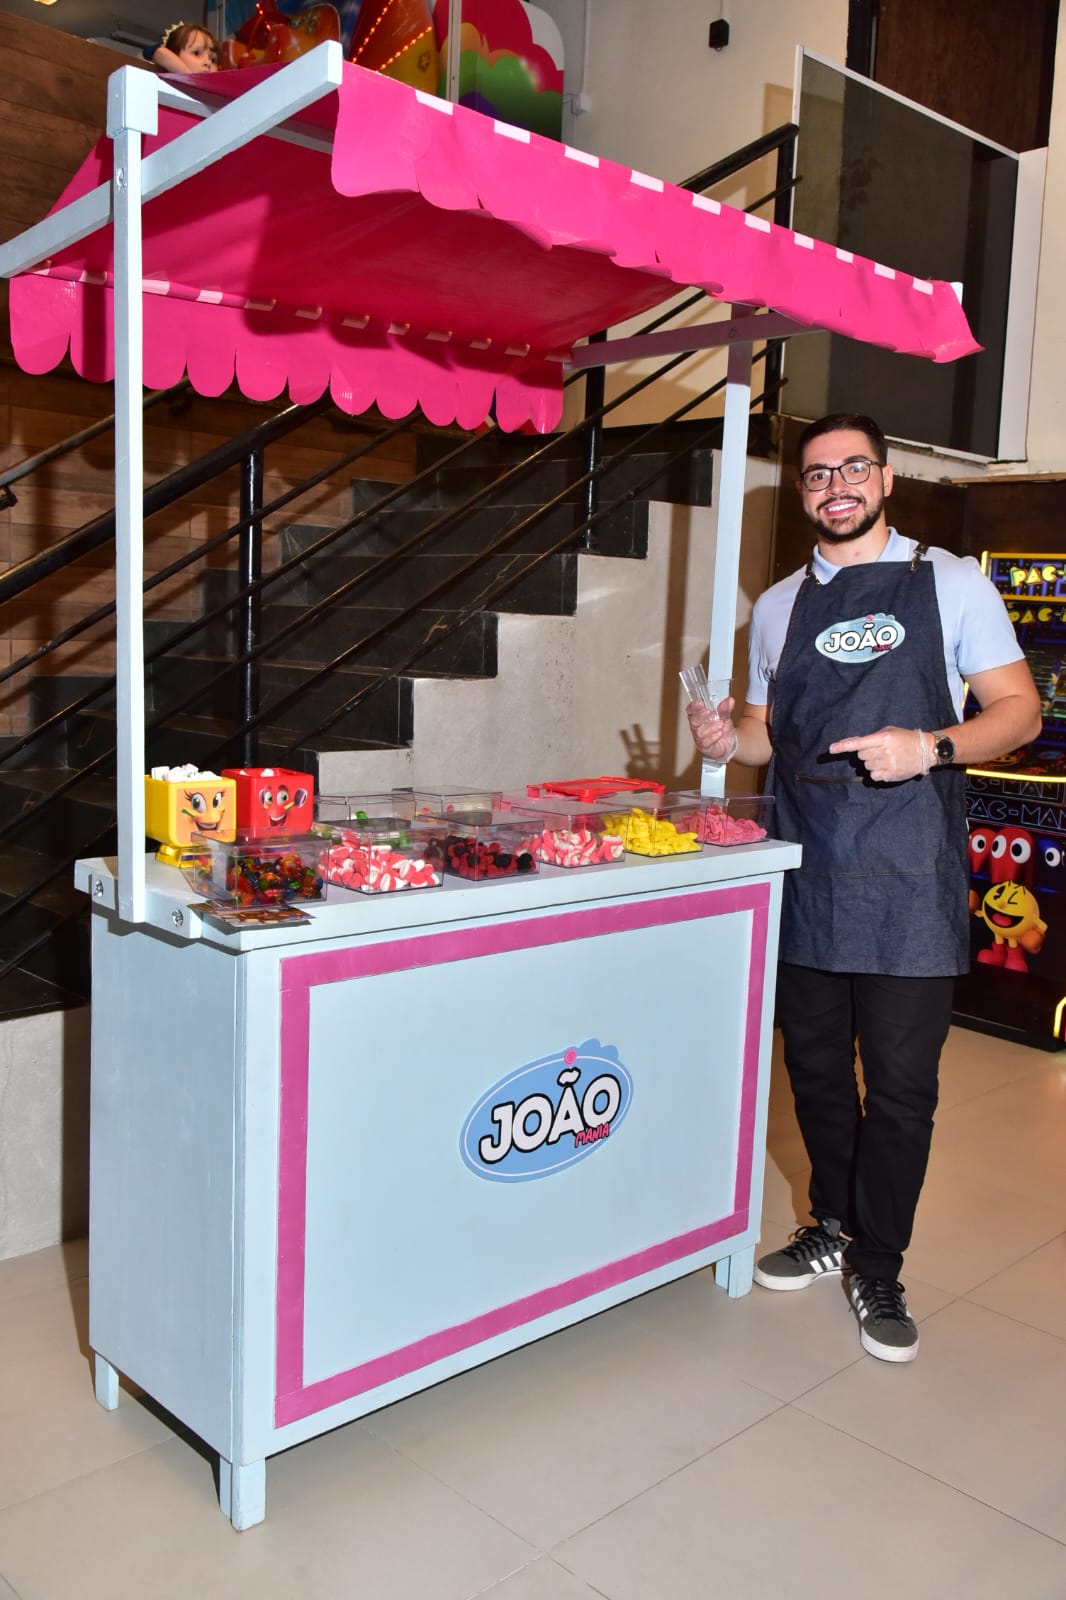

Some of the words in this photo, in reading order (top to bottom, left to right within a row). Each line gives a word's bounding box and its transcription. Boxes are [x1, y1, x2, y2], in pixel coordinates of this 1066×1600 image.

[1010, 564, 1066, 588] PAC-
[1008, 607, 1066, 624] PAC-
[823, 622, 898, 653] JOÃO
[479, 1067, 622, 1164] JOÃO
[574, 1121, 610, 1148] MANIA
